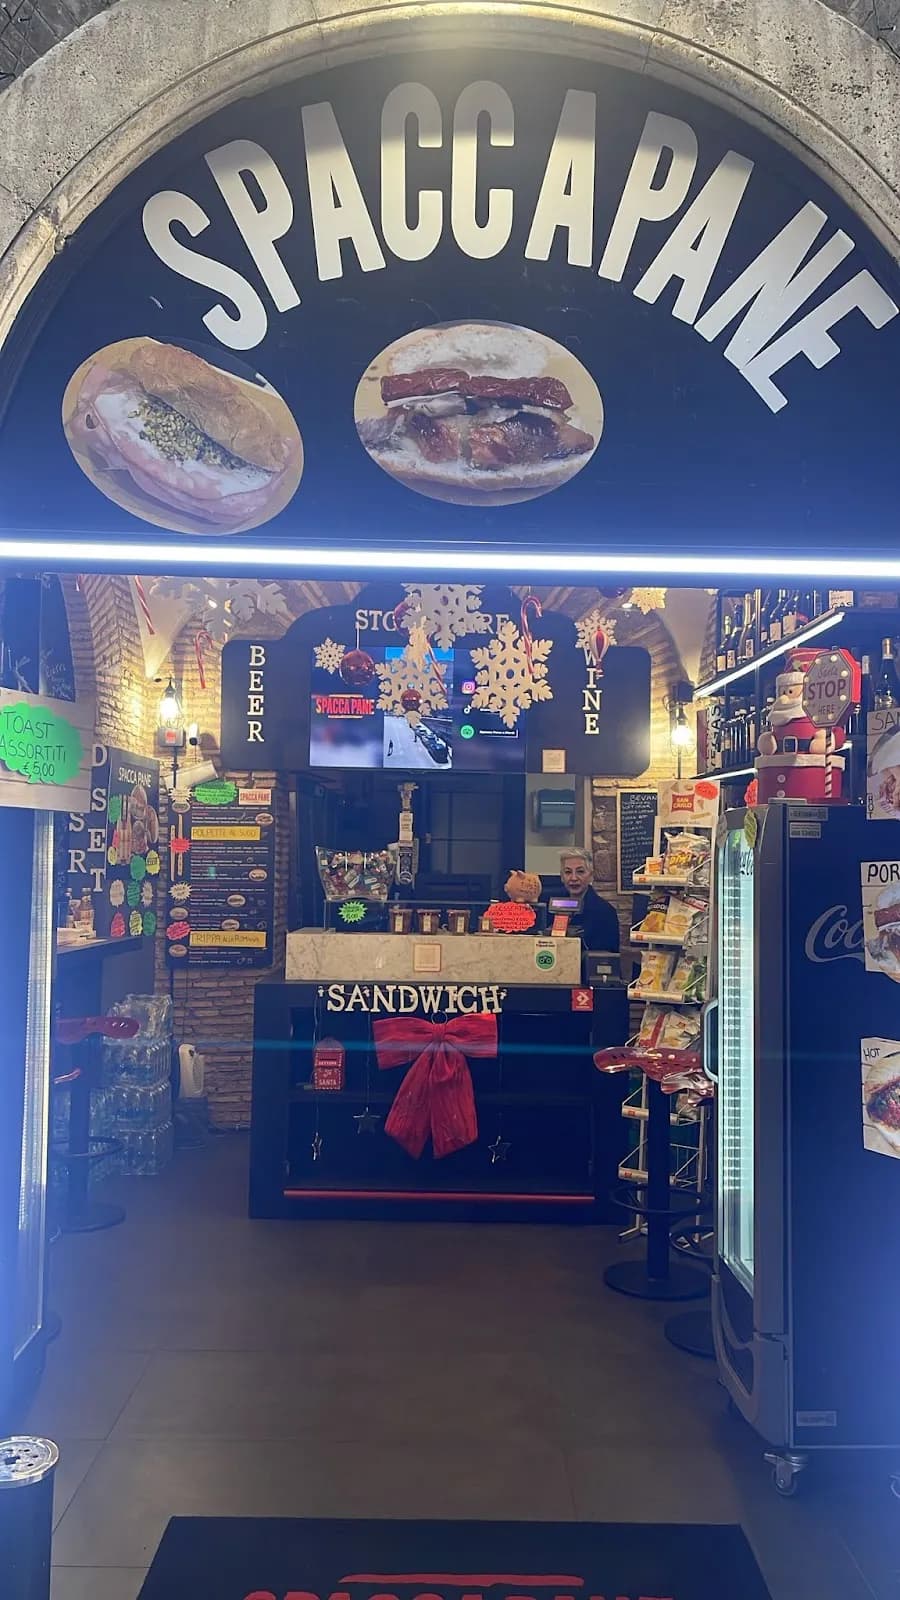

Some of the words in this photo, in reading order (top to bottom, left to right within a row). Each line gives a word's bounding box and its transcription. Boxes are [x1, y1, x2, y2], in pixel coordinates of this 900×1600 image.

[247, 645, 266, 742] BEER
[582, 646, 602, 735] WINE
[807, 678, 846, 700] STOP
[316, 697, 350, 714] SPACCA
[351, 698, 375, 715] PANE
[818, 704, 836, 715] HERE
[3, 711, 54, 739] TOAST
[0, 735, 66, 762] ASSORTITI
[327, 984, 502, 1014] SANDWICH
[863, 1047, 880, 1061] HOT
